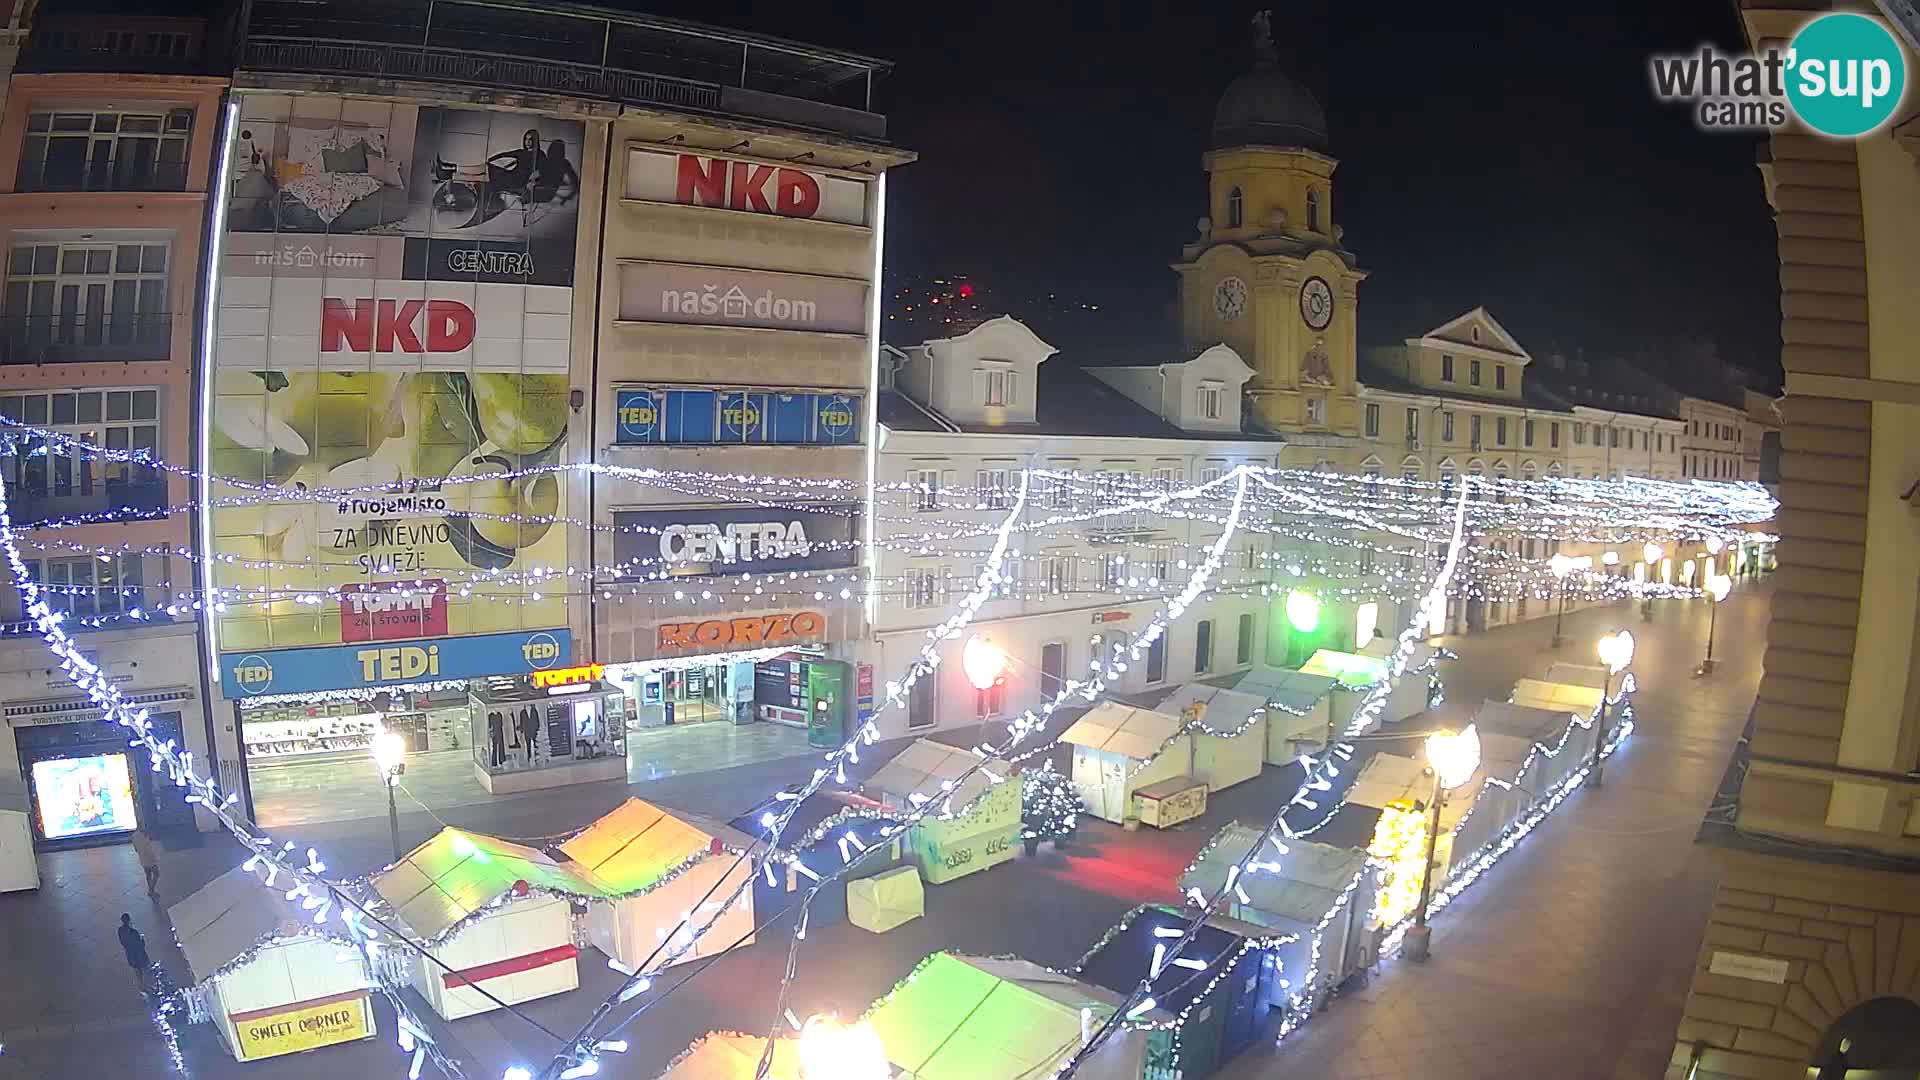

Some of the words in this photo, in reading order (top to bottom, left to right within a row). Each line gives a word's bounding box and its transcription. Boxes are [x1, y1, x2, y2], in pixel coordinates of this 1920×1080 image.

[676, 154, 819, 219] NKD
[320, 247, 366, 269] dom
[449, 249, 535, 276] CENTRA
[661, 284, 718, 316] naš
[754, 291, 816, 321] dom
[320, 297, 476, 353] NKD
[334, 528, 357, 549] ZA
[368, 523, 450, 547] DNEVNO
[659, 520, 810, 563] CENTRA
[352, 589, 434, 614] TOMMY
[658, 611, 824, 649] KORZO
[357, 645, 439, 681] TEDi
[522, 641, 559, 662] TEDi
[233, 666, 273, 685] TEDi
[533, 663, 603, 688] TOMMY
[249, 1021, 292, 1041] SWEET
